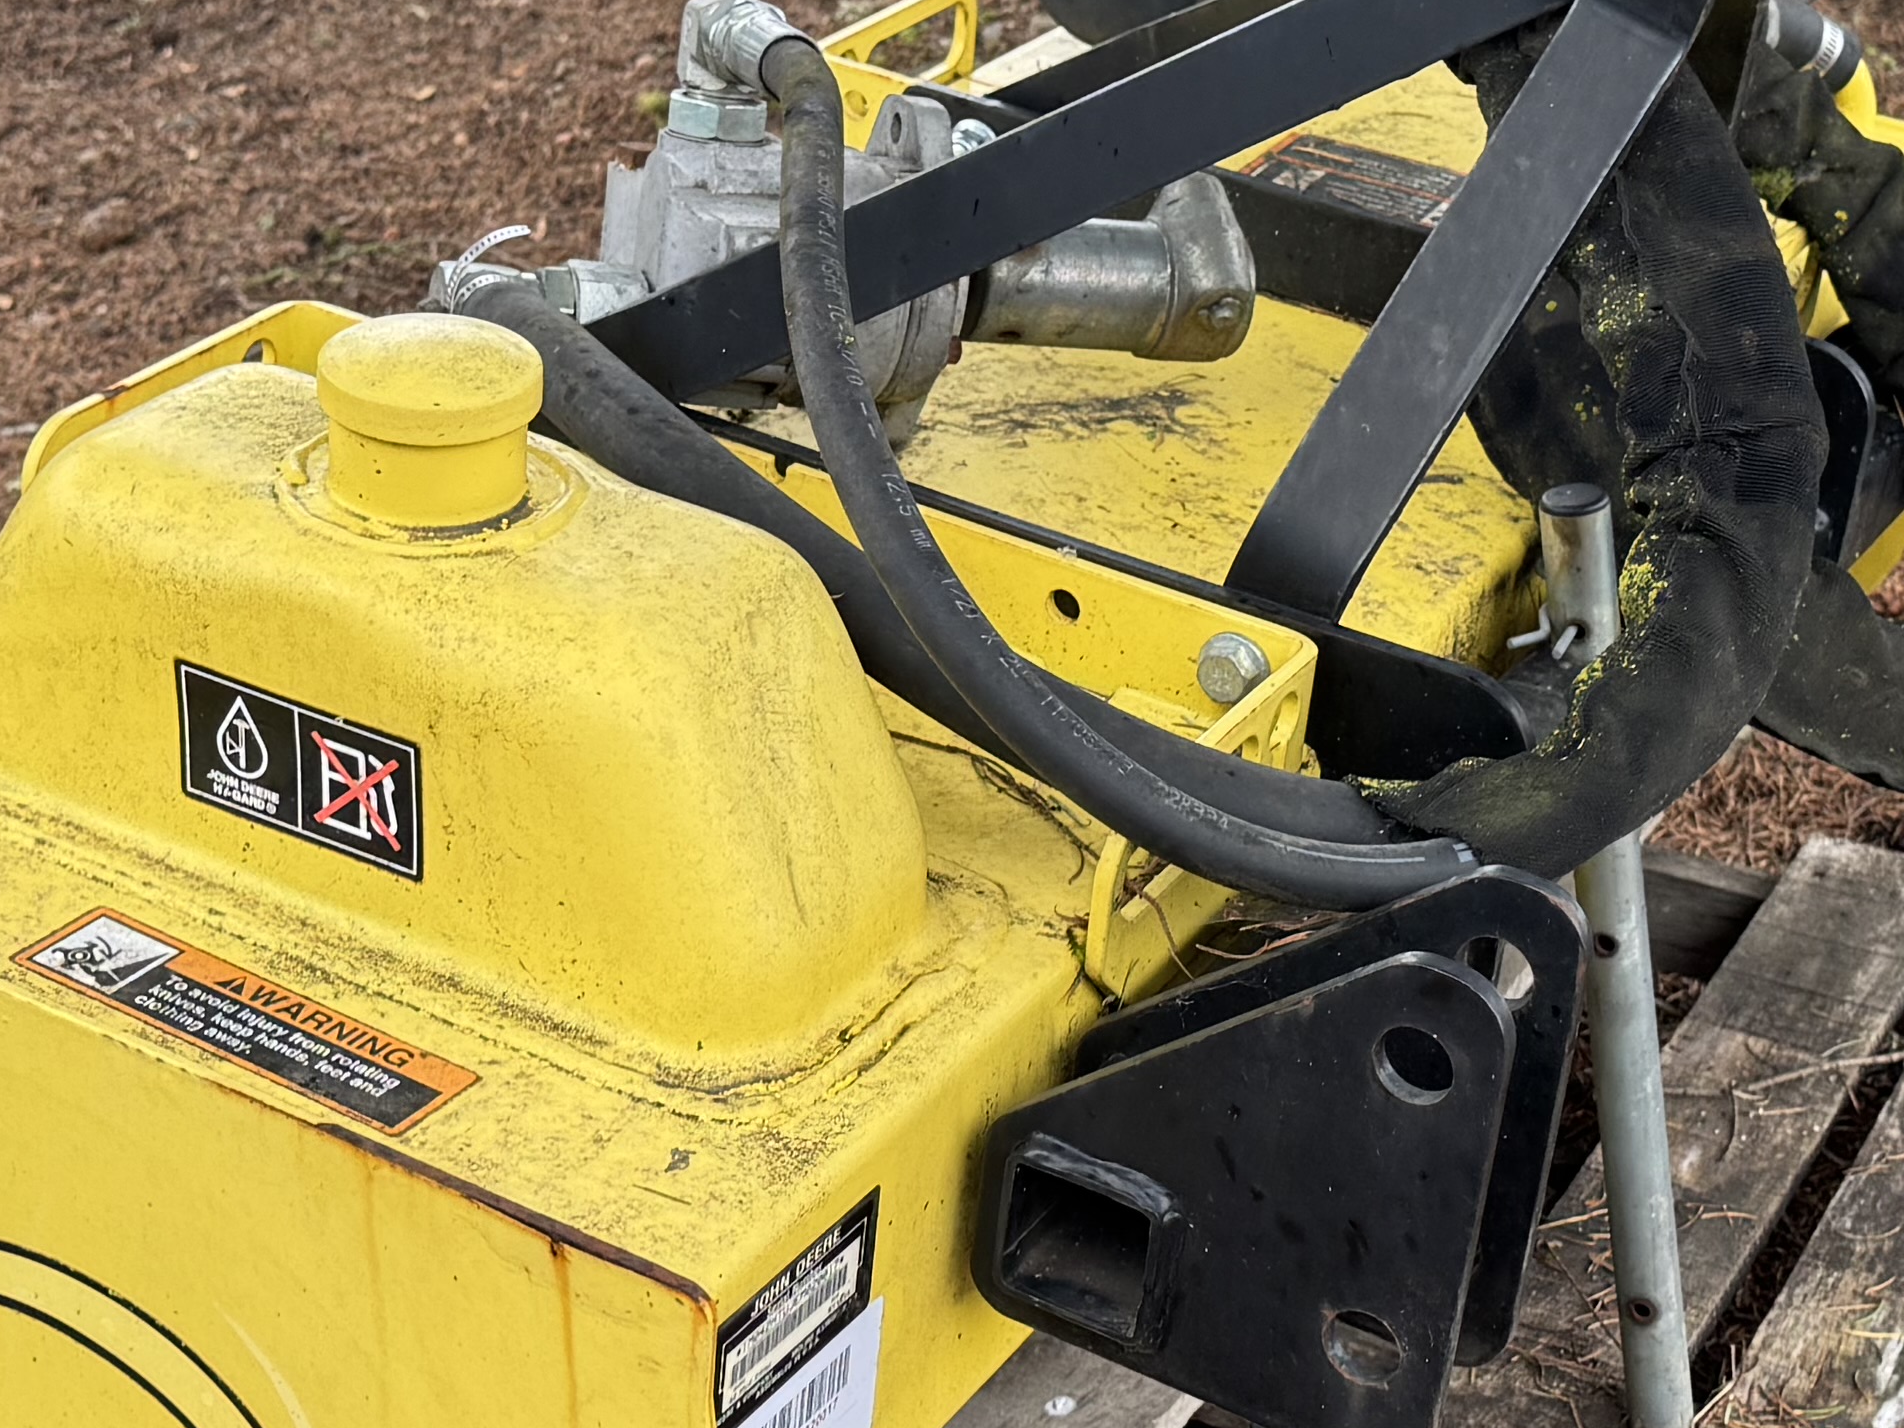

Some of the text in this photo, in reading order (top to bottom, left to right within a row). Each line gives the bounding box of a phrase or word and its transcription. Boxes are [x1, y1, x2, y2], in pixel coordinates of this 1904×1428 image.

[207, 769, 279, 804] JOHN DEERE
[134, 995, 252, 1054] clothing away.
[148, 984, 388, 1097] knives, keep hands, feet and
[166, 974, 400, 1089] To avoid injury from rotating
[248, 985, 415, 1068] WARNING
[751, 1271, 790, 1317] JOHN
[796, 1226, 841, 1278] DEERE
